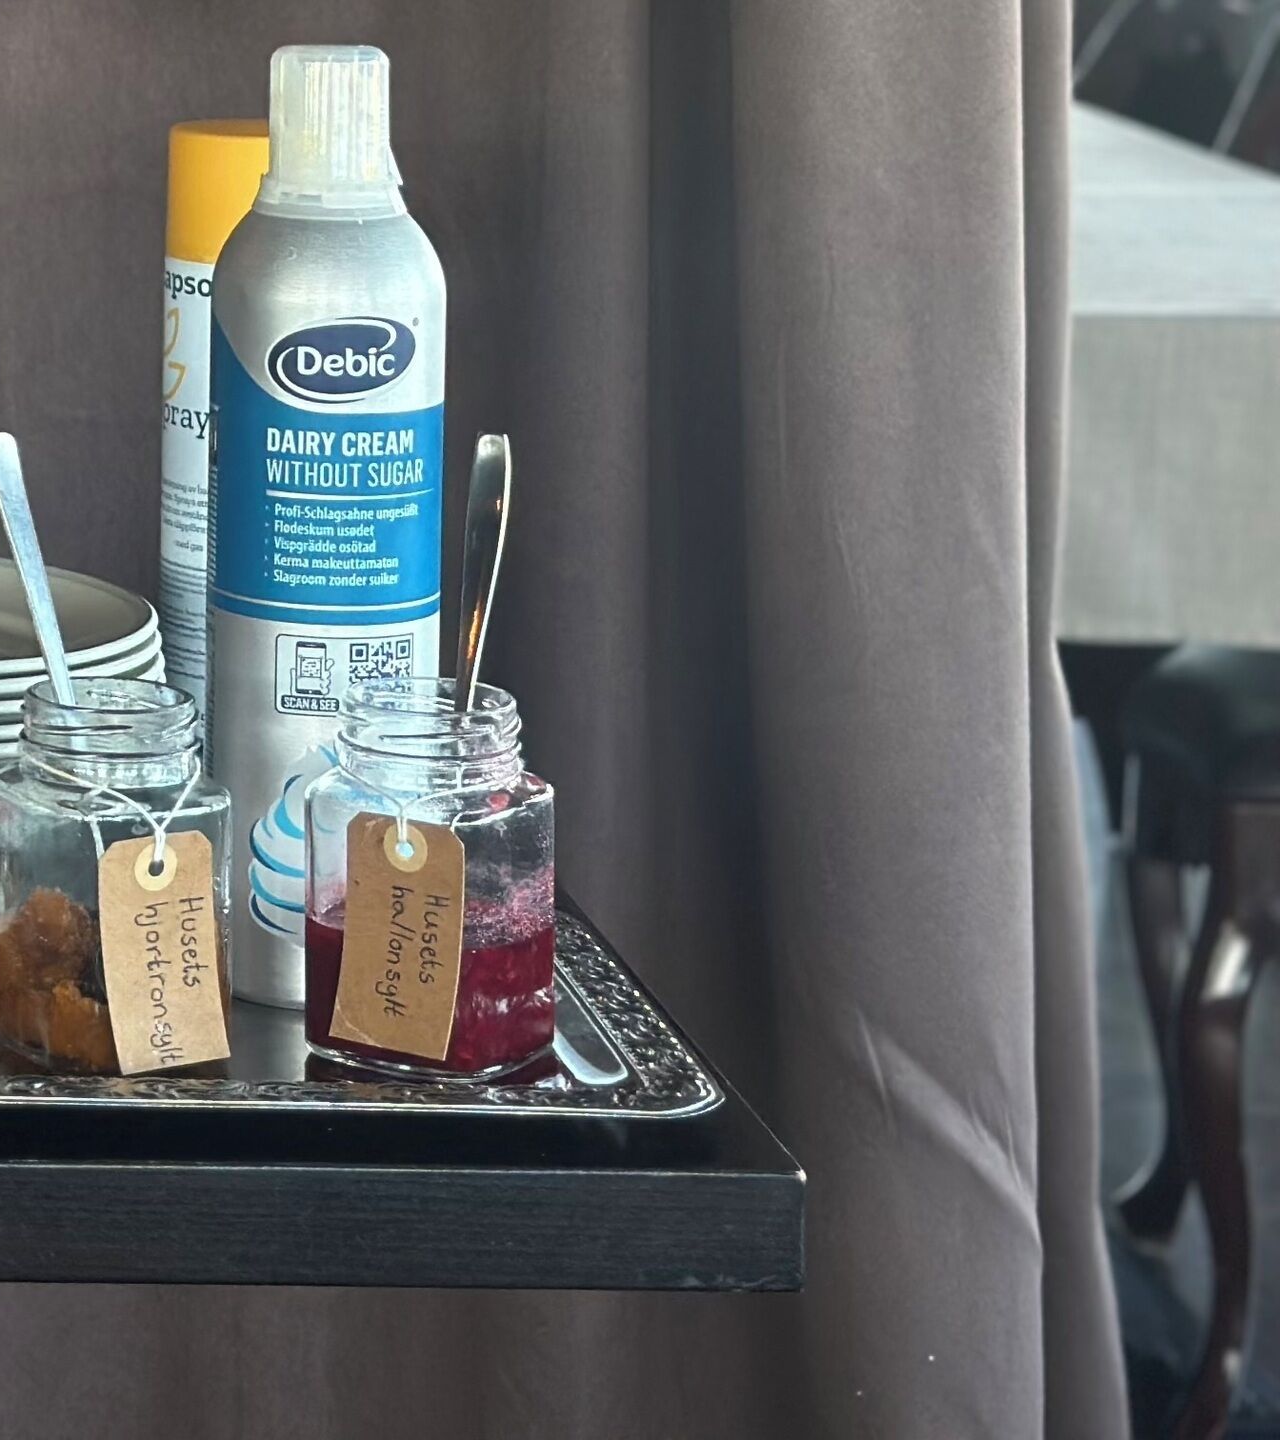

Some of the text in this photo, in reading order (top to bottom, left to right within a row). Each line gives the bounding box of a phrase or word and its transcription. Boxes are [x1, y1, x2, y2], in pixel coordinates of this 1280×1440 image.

[297, 347, 395, 377] Debic
[267, 427, 414, 457] DAIRY CREAM
[266, 459, 424, 488] WITHOUT SUGAR
[274, 503, 374, 523] Profi-Schlagsahne
[273, 536, 376, 554] Vispgrädde osötad
[273, 553, 399, 569] Kerma makeuttamaton
[273, 569, 326, 586] Slagroom
[329, 573, 367, 586] zonder
[282, 696, 338, 711] SCAN & SEE
[179, 896, 208, 987] Husets
[418, 893, 450, 984] Husets
